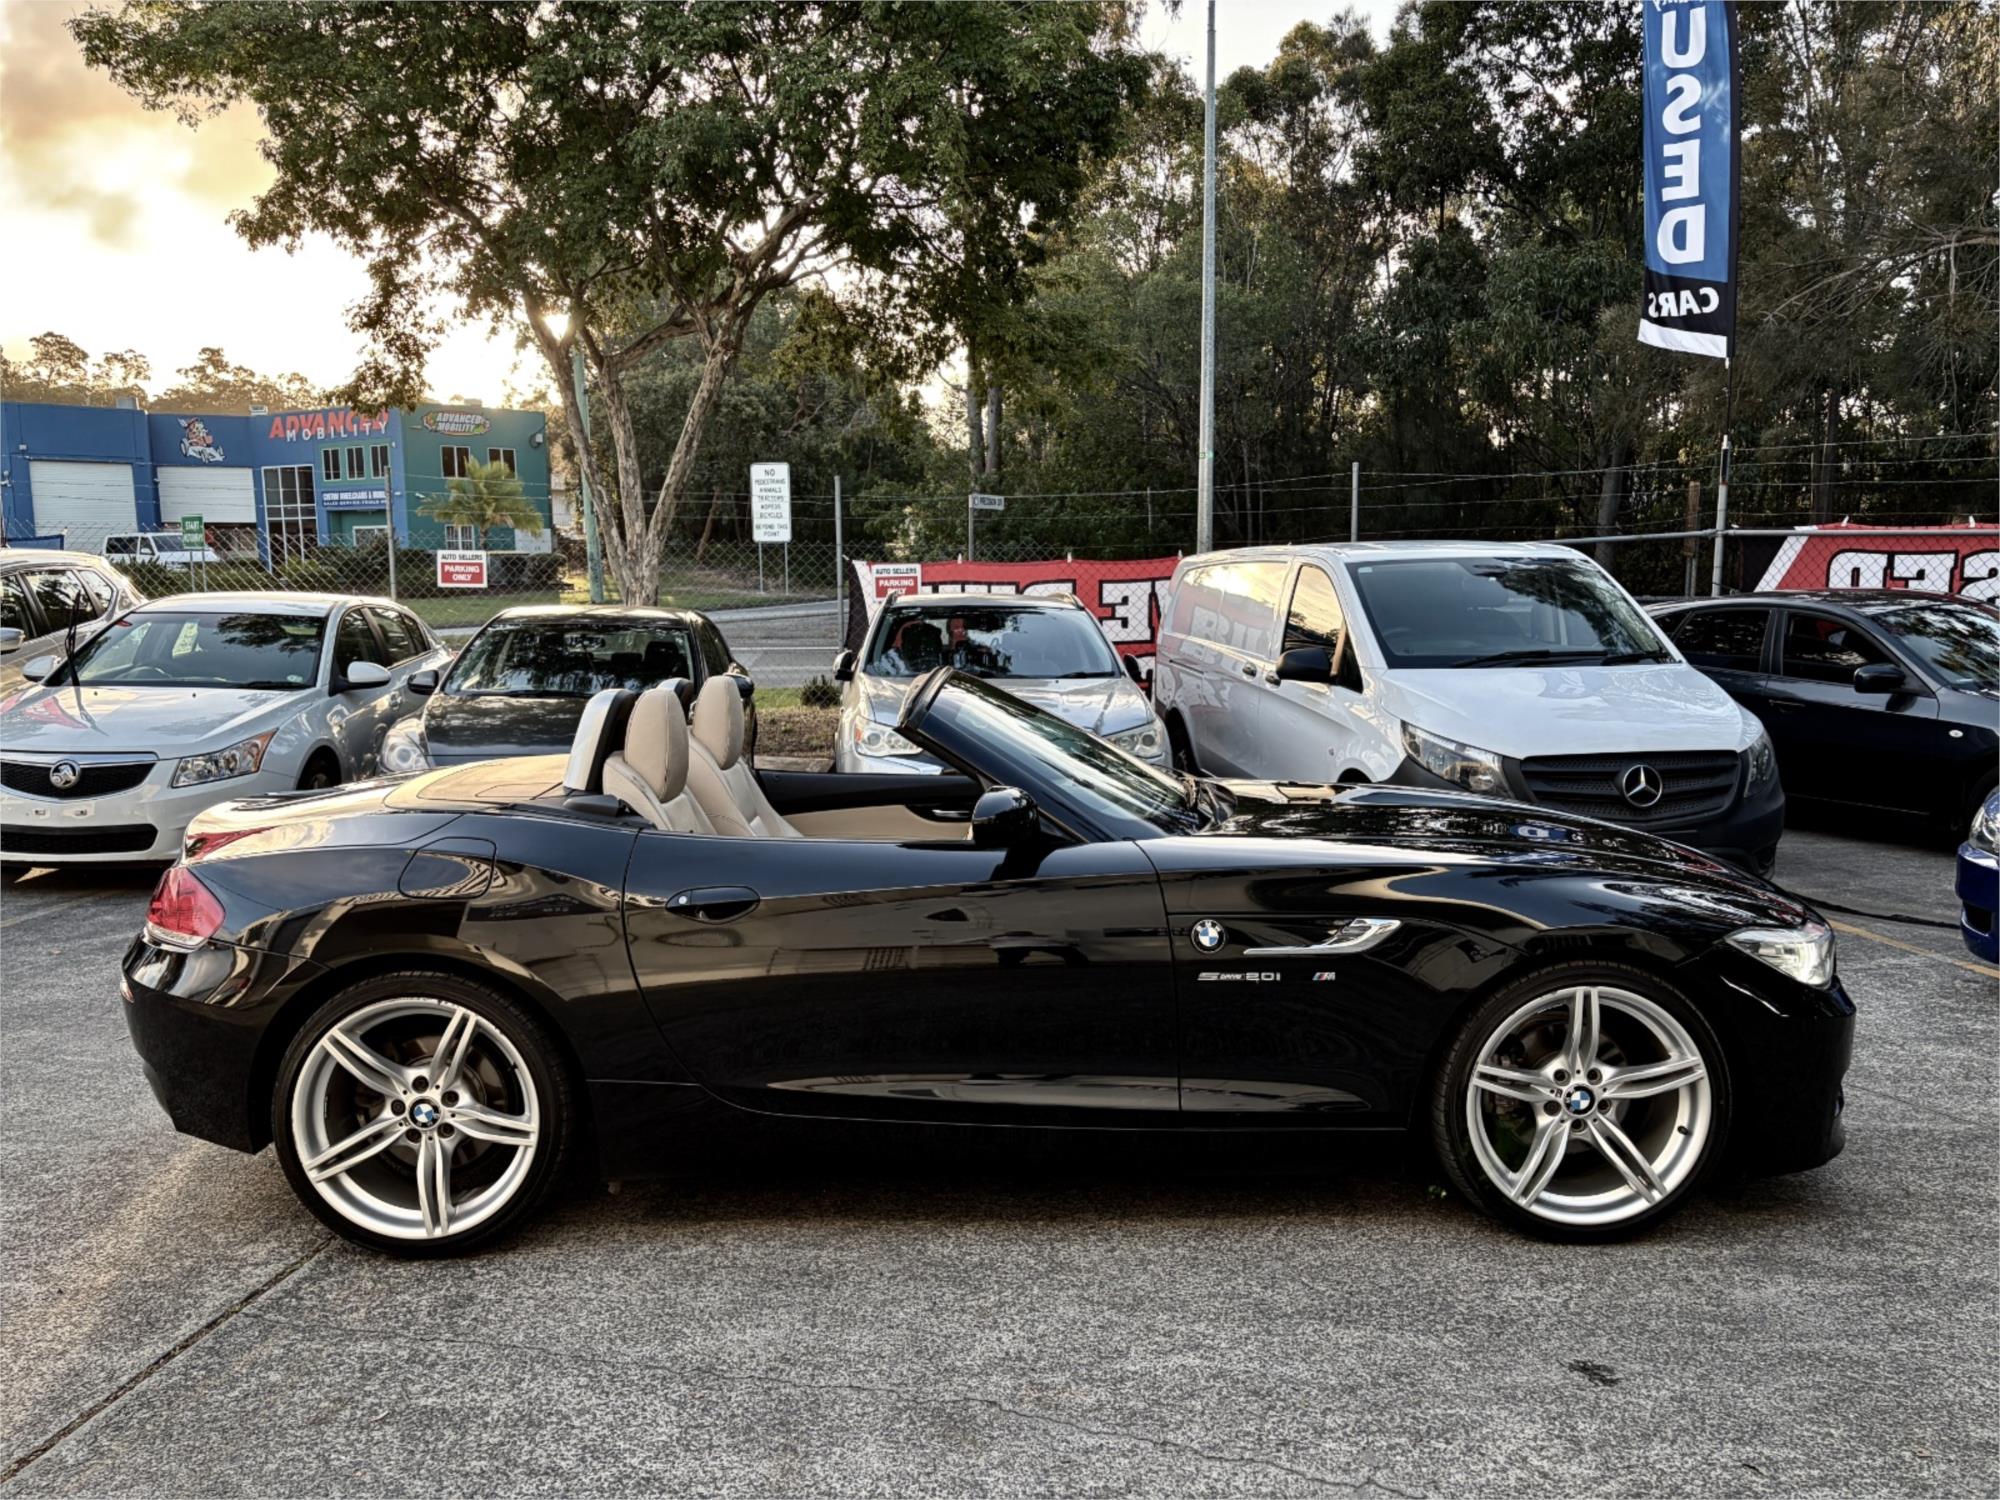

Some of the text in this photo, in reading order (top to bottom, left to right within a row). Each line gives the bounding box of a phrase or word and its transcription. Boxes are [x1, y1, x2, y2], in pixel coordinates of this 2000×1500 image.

[436, 412, 481, 424] ADVANCED
[270, 408, 388, 438] ADVANCED
[436, 422, 476, 432] MOBILITY
[286, 421, 387, 442] MOBILITY
[764, 468, 776, 477] NO
[441, 553, 457, 561] AUTO
[444, 564, 480, 573] PARKING
[892, 567, 917, 575] SELLERS
[452, 573, 473, 581] ONLY
[879, 579, 915, 588] PARKING
